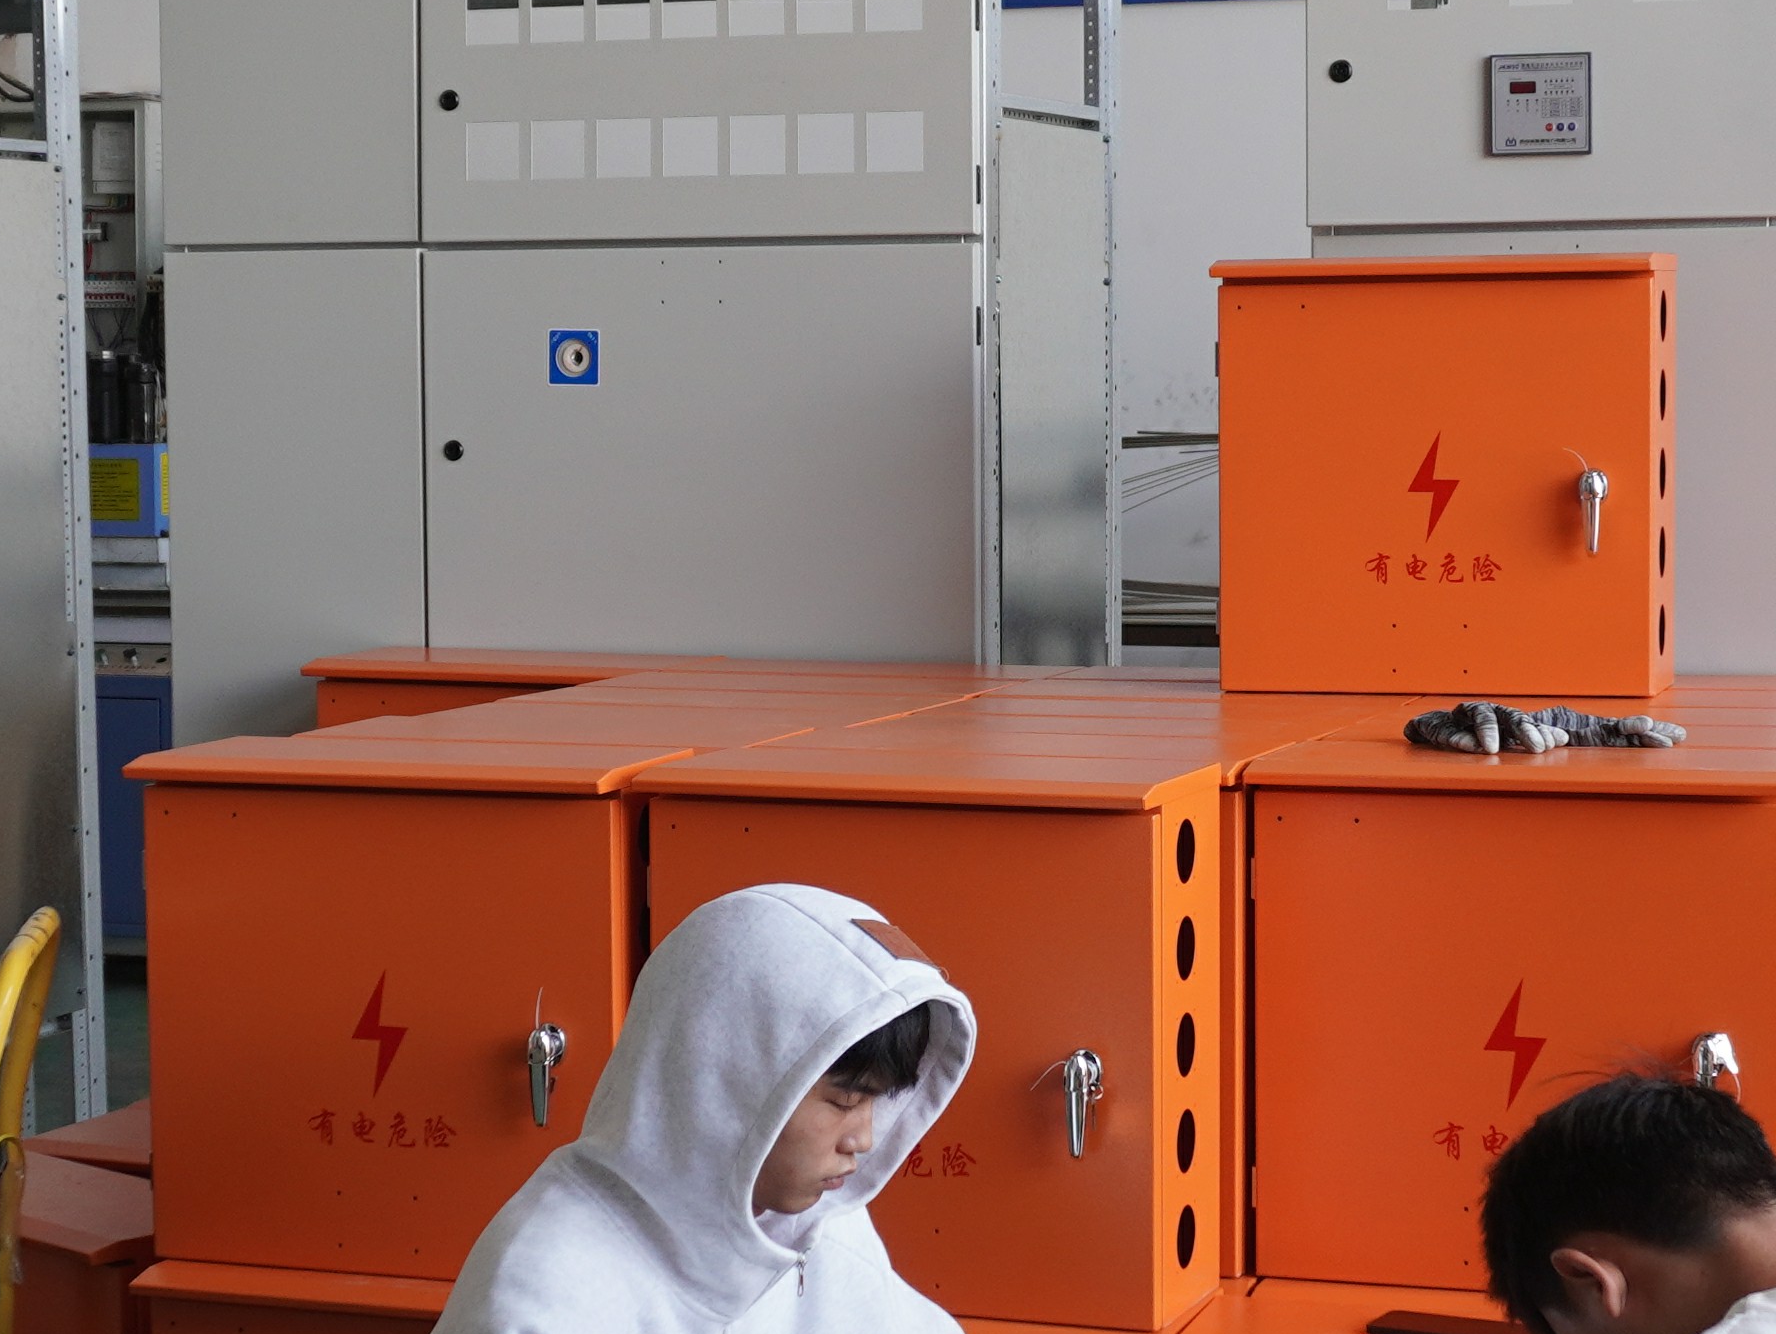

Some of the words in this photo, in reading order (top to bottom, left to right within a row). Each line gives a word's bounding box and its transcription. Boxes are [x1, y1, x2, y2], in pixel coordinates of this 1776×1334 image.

[1363, 552, 1503, 586] 有电危险
[307, 1108, 458, 1150] 有电危险
[1432, 1121, 1510, 1161] 有电
[902, 1142, 977, 1180] 危险
